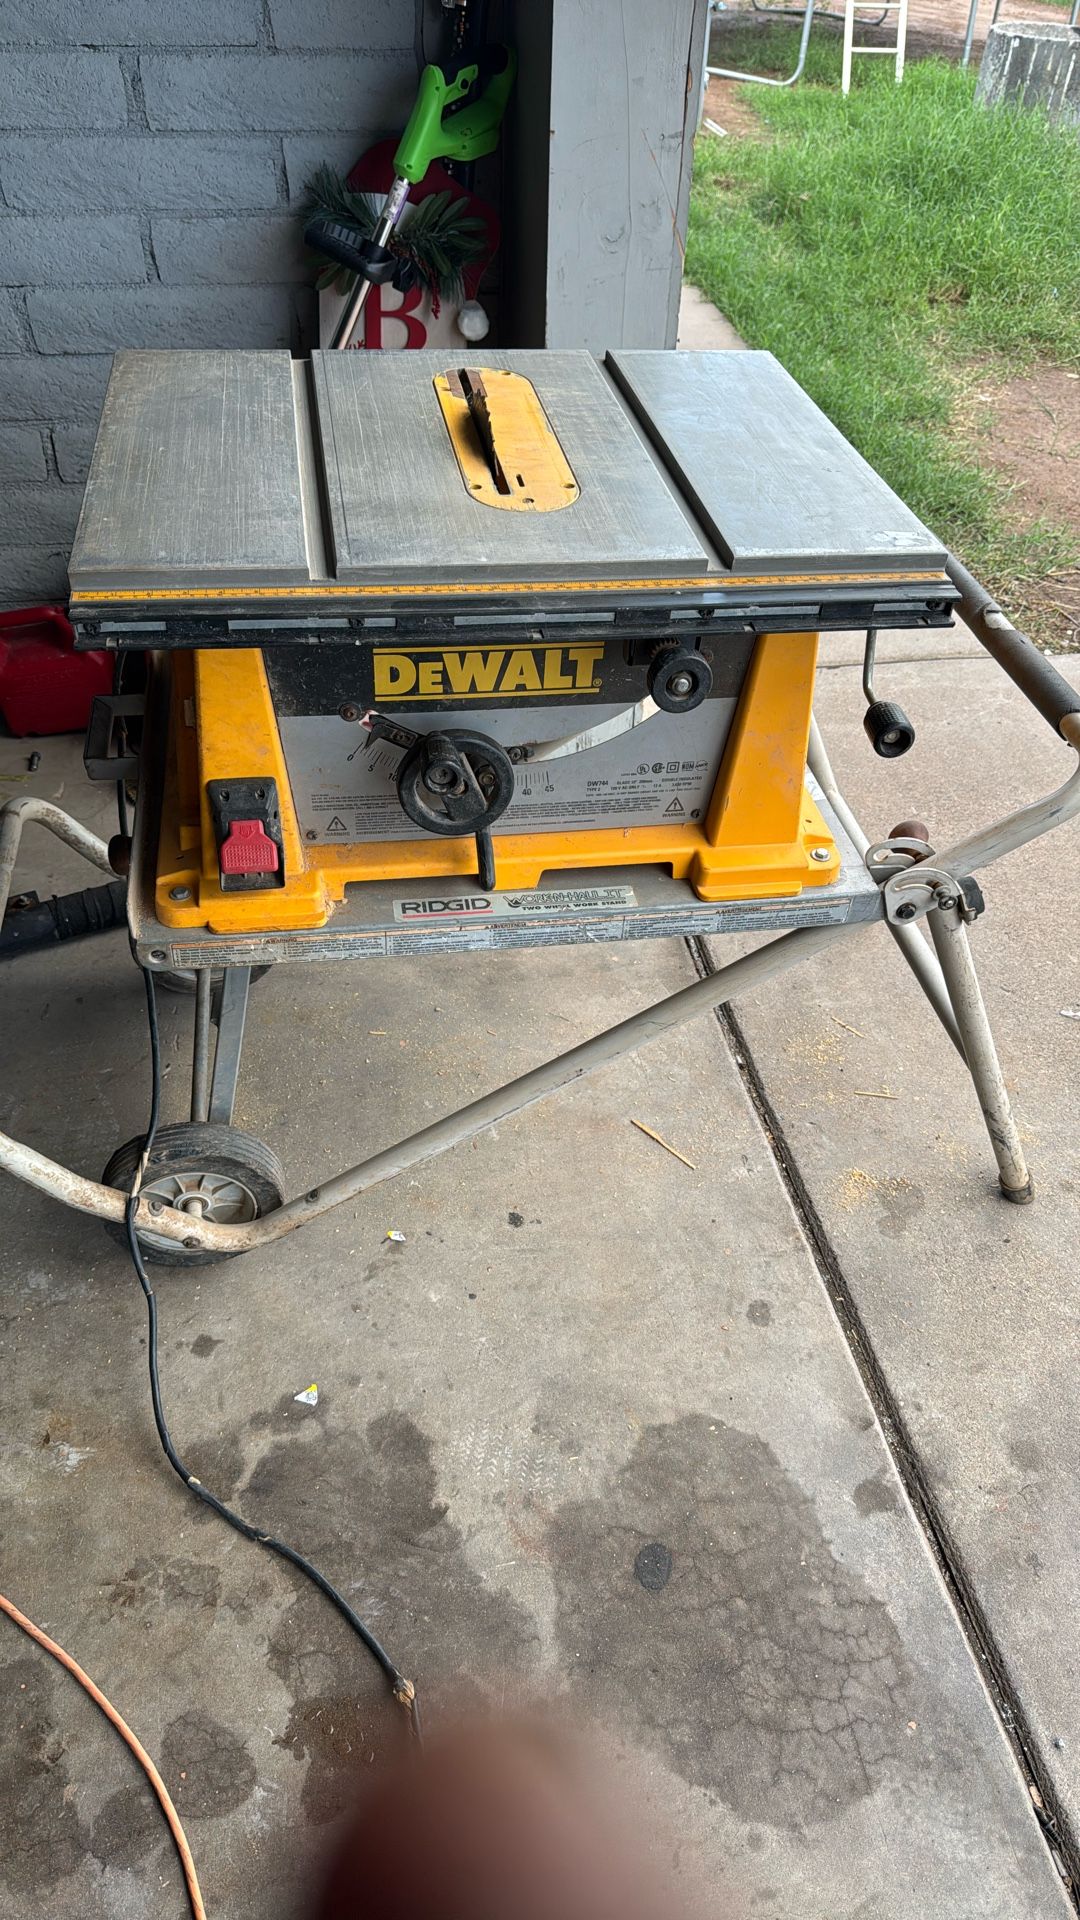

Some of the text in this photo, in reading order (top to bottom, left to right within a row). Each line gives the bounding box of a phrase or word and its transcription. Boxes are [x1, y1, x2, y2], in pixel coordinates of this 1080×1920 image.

[364, 283, 427, 349] B
[368, 764, 374, 772] 5
[522, 788, 532, 796] 40
[544, 784, 555, 792] 45
[401, 898, 491, 914] RIDGID
